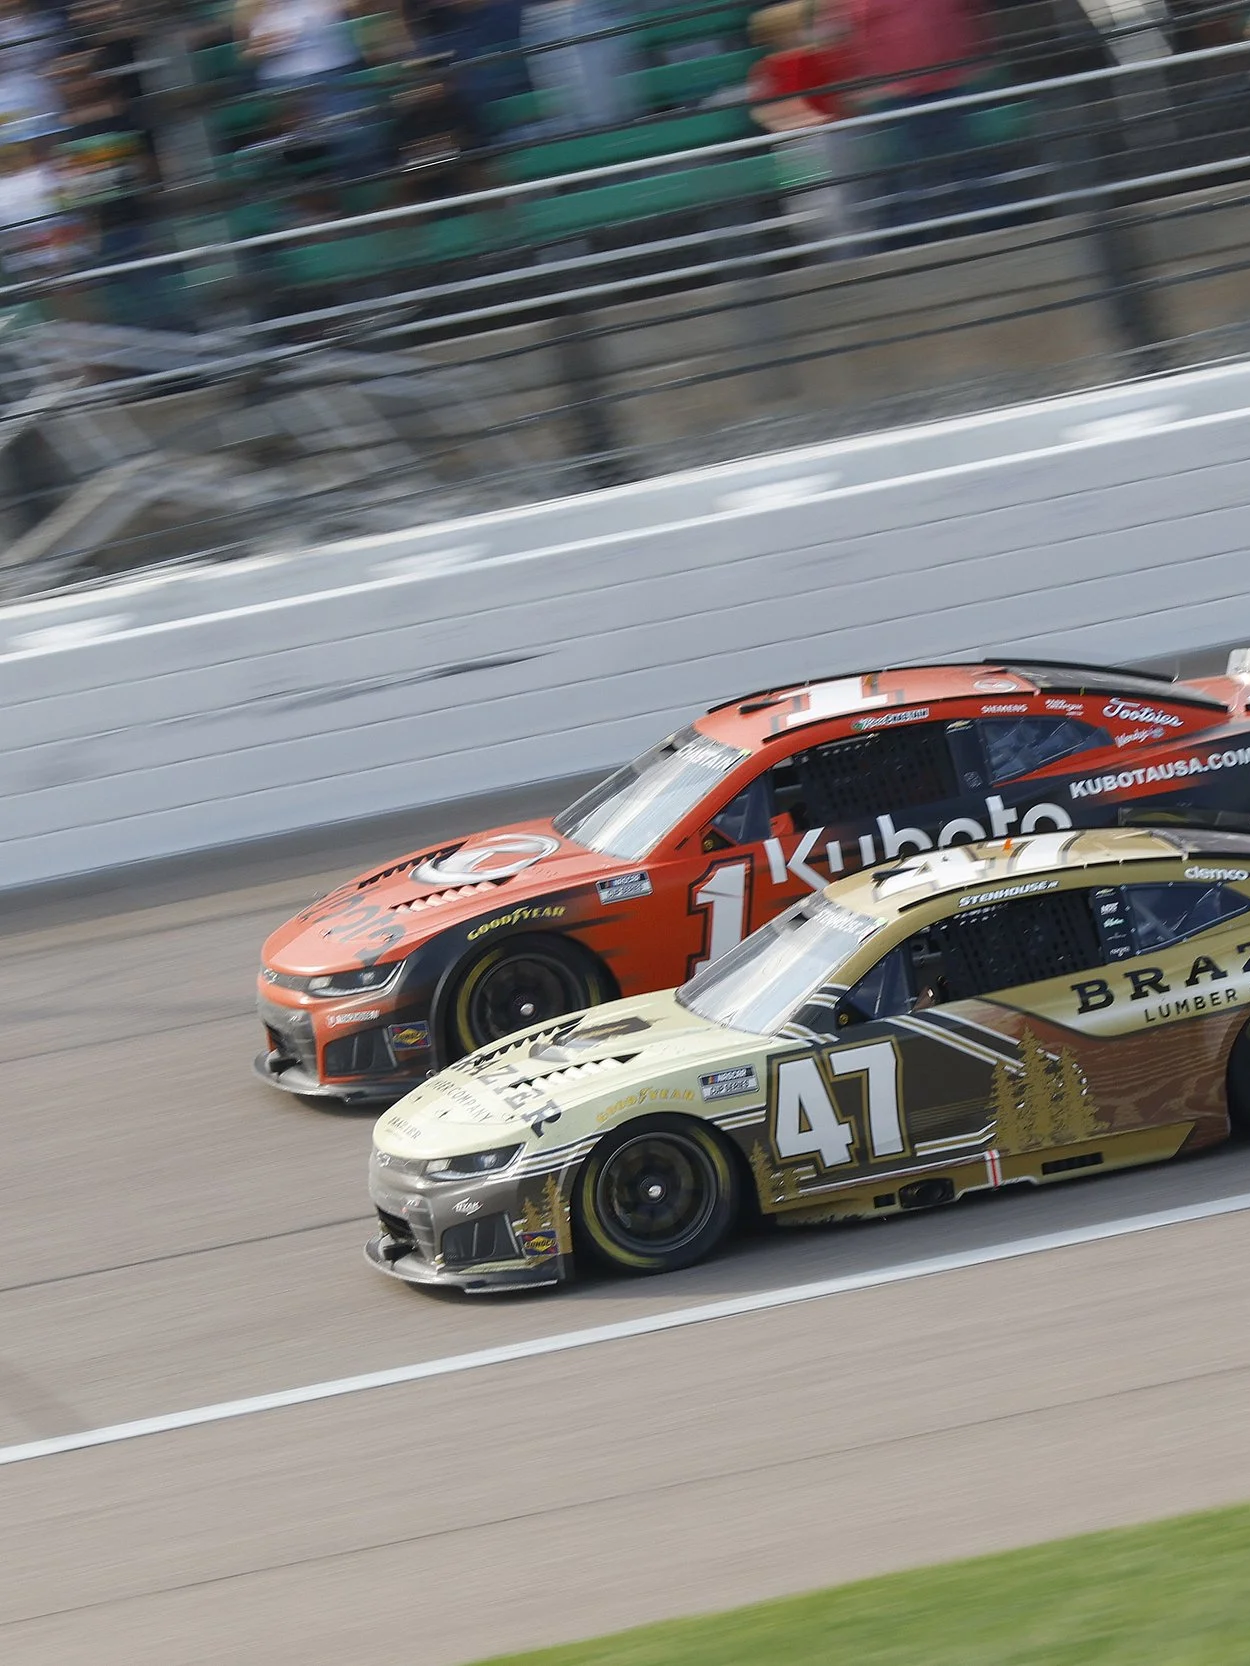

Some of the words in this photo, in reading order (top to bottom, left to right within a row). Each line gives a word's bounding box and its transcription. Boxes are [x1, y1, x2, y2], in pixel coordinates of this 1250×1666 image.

[981, 703, 1029, 715] SIEMENS
[958, 880, 1048, 907] STENHOUSE
[467, 906, 567, 941] GOODYEAR
[694, 861, 748, 974] 1
[1143, 988, 1238, 1023] LUMBER
[719, 1068, 747, 1082] NASCAR
[595, 1087, 695, 1122] GOODYEAR
[774, 1040, 905, 1170] 47
[525, 1238, 557, 1250] SUNOCO
